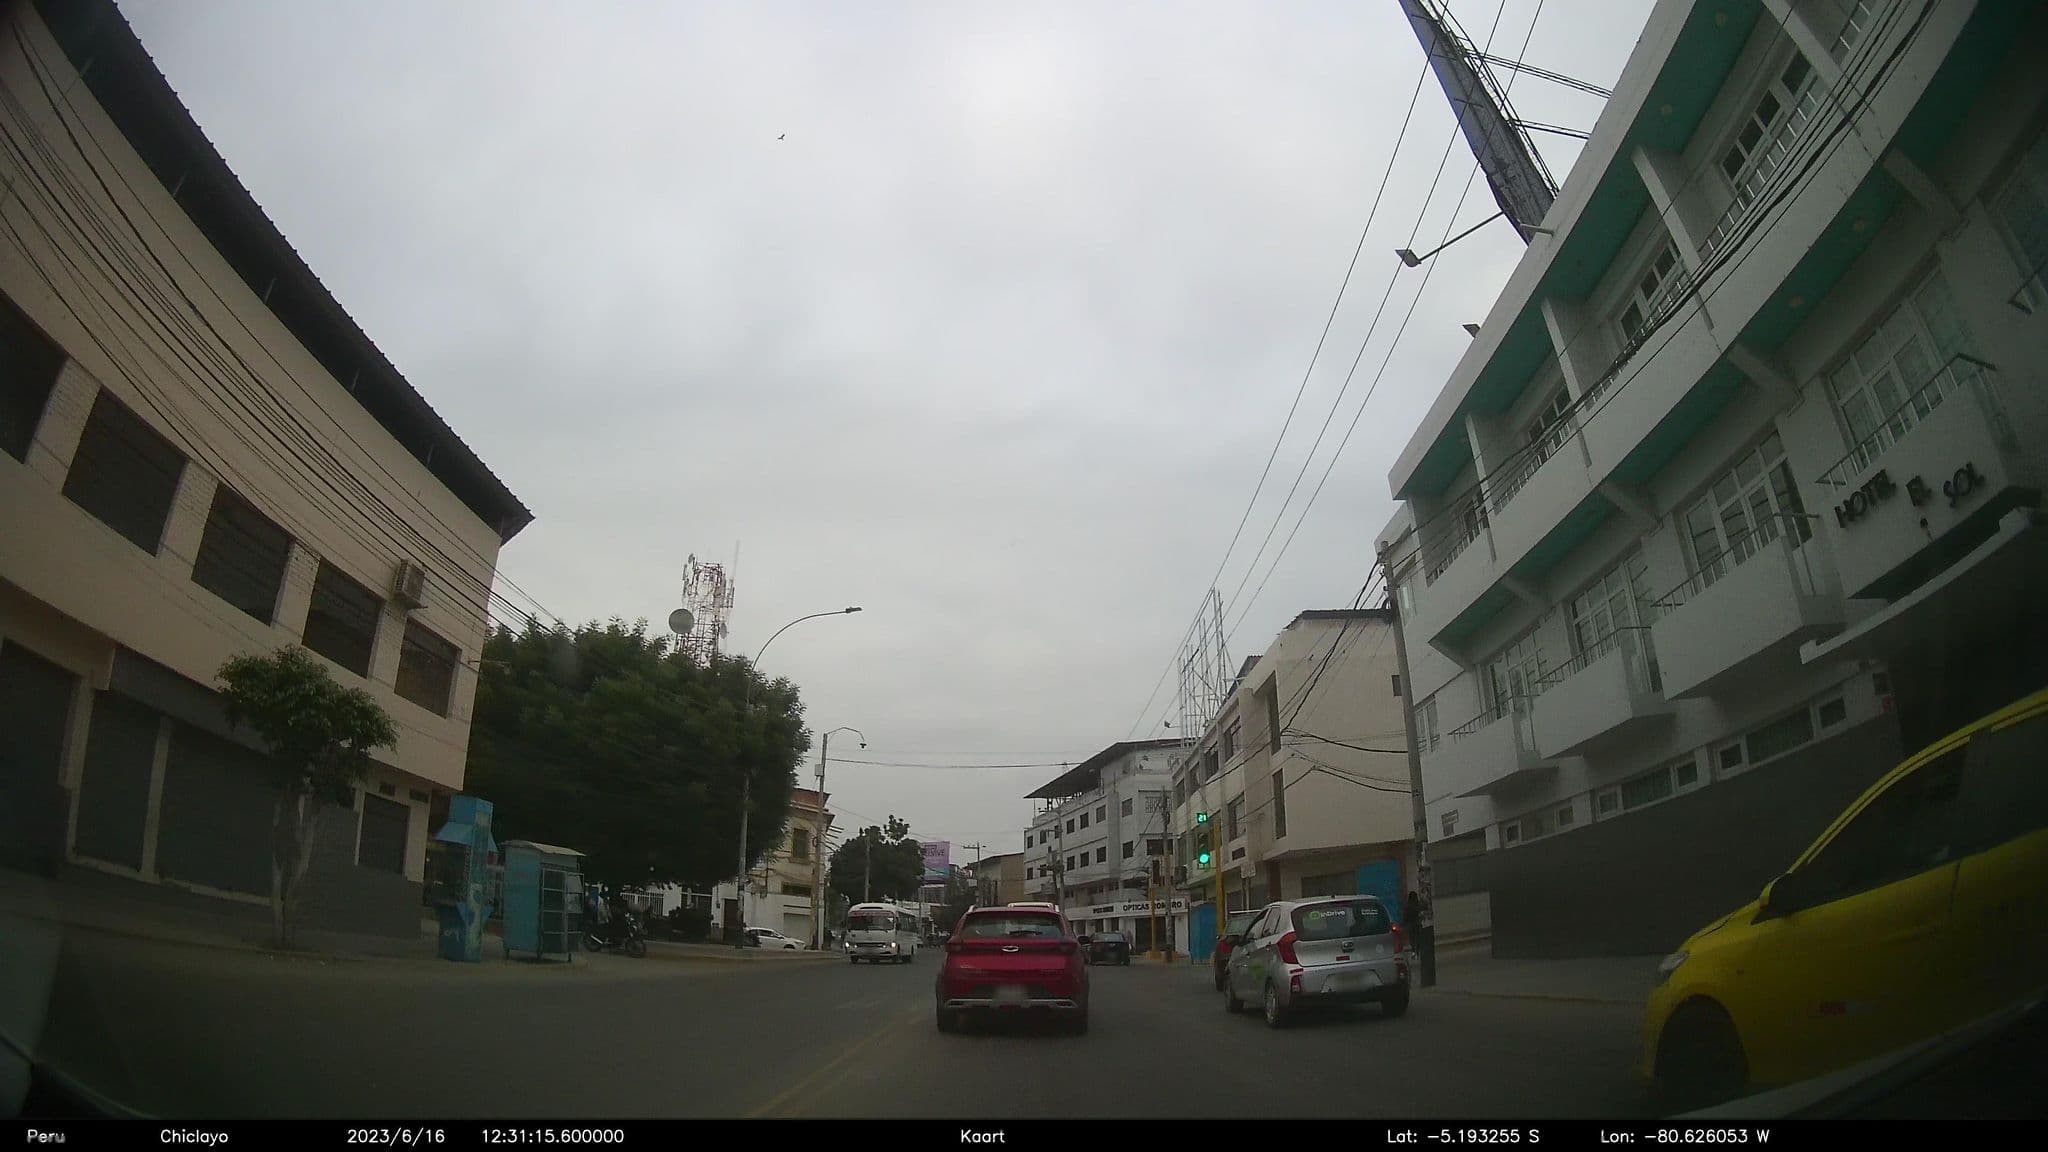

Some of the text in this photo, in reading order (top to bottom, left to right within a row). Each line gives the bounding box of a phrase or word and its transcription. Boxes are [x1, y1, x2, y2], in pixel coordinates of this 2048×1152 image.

[1834, 469, 1897, 528] HOTEL
[1942, 461, 1985, 508] SOL
[1198, 814, 1207, 822] 21
[1152, 901, 1183, 911] ORO
